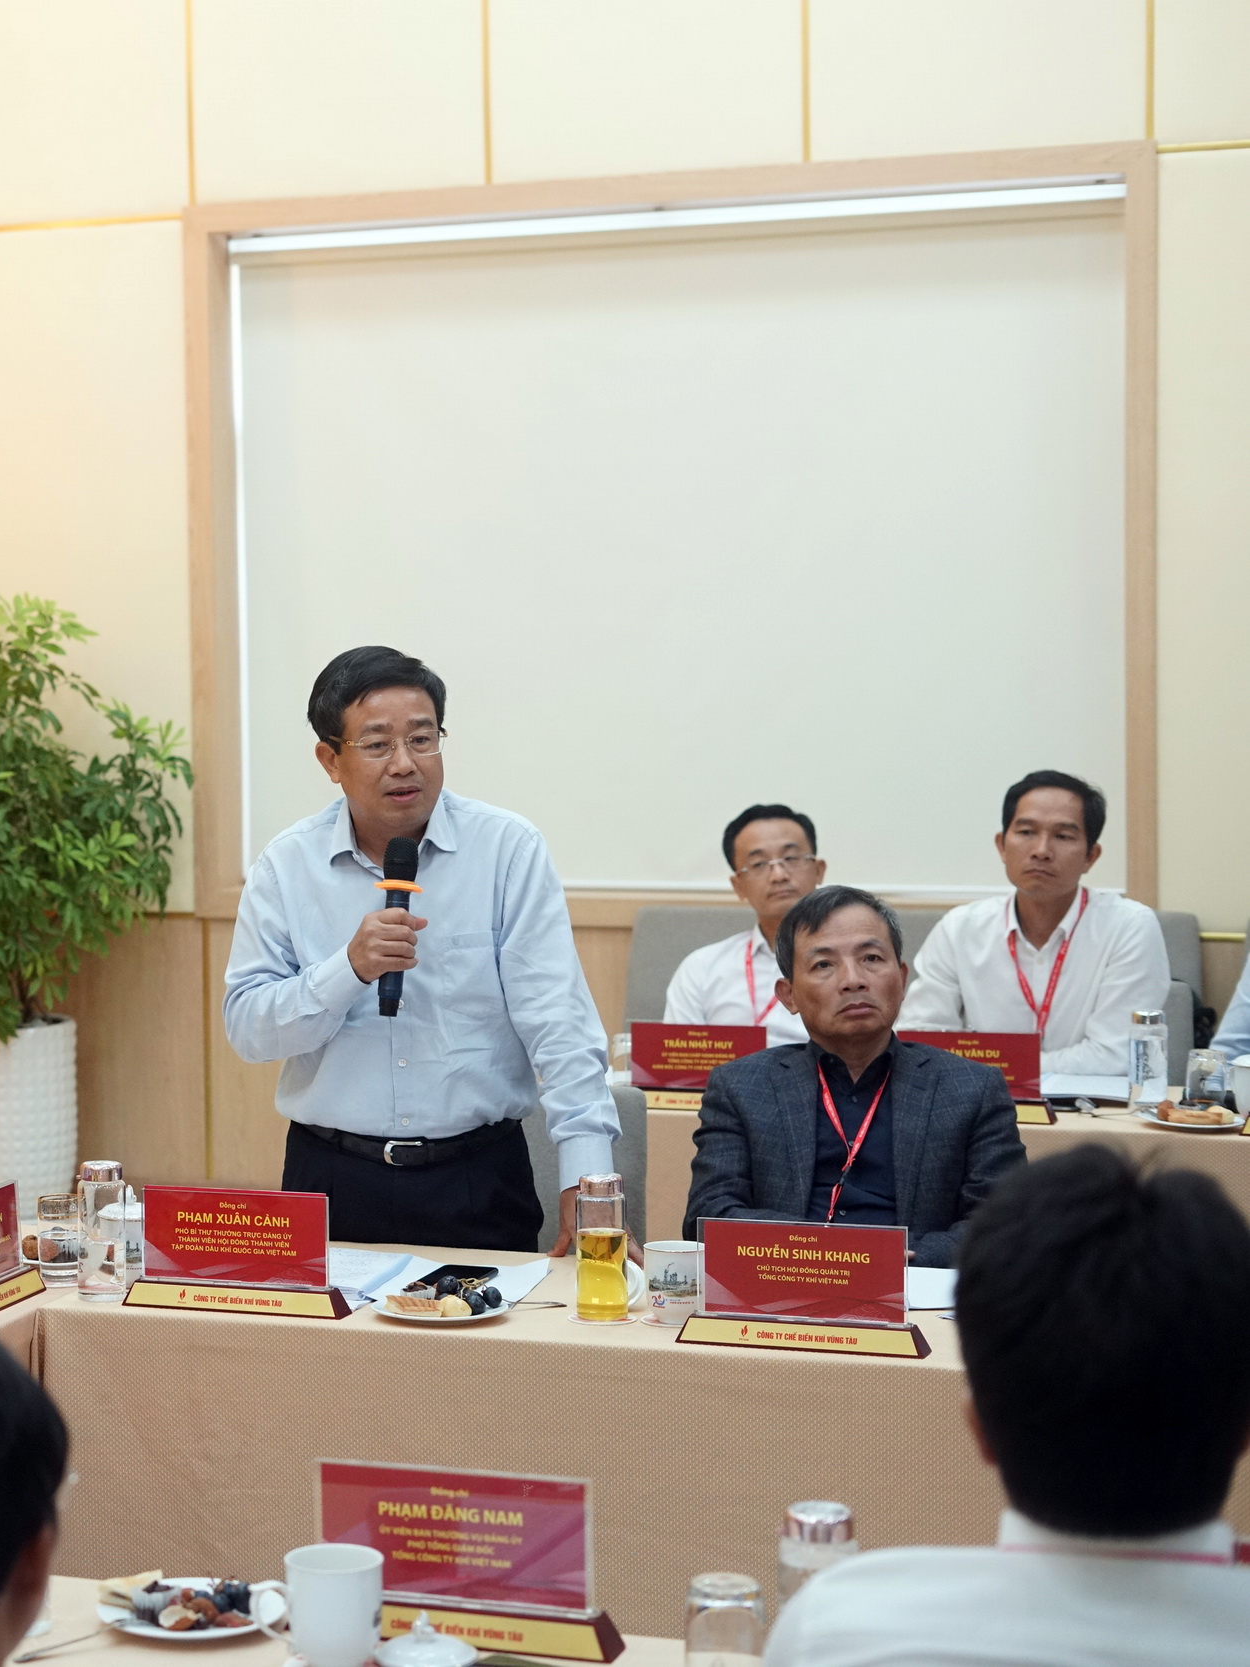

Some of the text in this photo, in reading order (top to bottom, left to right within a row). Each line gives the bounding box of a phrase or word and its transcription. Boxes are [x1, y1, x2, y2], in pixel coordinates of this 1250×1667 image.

[714, 1040, 733, 1049] HUY
[986, 1050, 1000, 1058] DU
[219, 1201, 236, 1210] Đồng
[177, 1211, 290, 1228] PHẠM XUÂN CẢNH
[243, 1231, 261, 1239] TRỰC
[789, 1235, 806, 1243] Đồng
[178, 1235, 200, 1243] THÀNH
[201, 1236, 216, 1244] VIÊN
[217, 1237, 229, 1245] HỘI
[251, 1239, 273, 1247] THÀNH
[274, 1240, 290, 1248] VIÊN
[171, 1243, 184, 1251] TẬP
[266, 1248, 280, 1257] VIỆT
[737, 1244, 870, 1264] NGUYỄN SINH KHANG
[771, 1265, 786, 1273] TỊCH
[799, 1267, 819, 1275] ĐỒNG
[820, 1268, 839, 1276] QUẢN
[758, 1273, 776, 1281] TỔNG
[777, 1274, 796, 1282] CÔNG
[818, 1277, 832, 1285] VIỆT
[193, 1294, 209, 1302] CÔNG
[217, 1295, 229, 1303] CHẾ
[230, 1296, 243, 1304] BIẾN
[271, 1299, 282, 1307] TÀU
[756, 1330, 858, 1345] CÔNG TY CHẾ BIẾN KHÍ VŨNG TÀU
[378, 1501, 524, 1527] PHẠM ĐĂNG NAM
